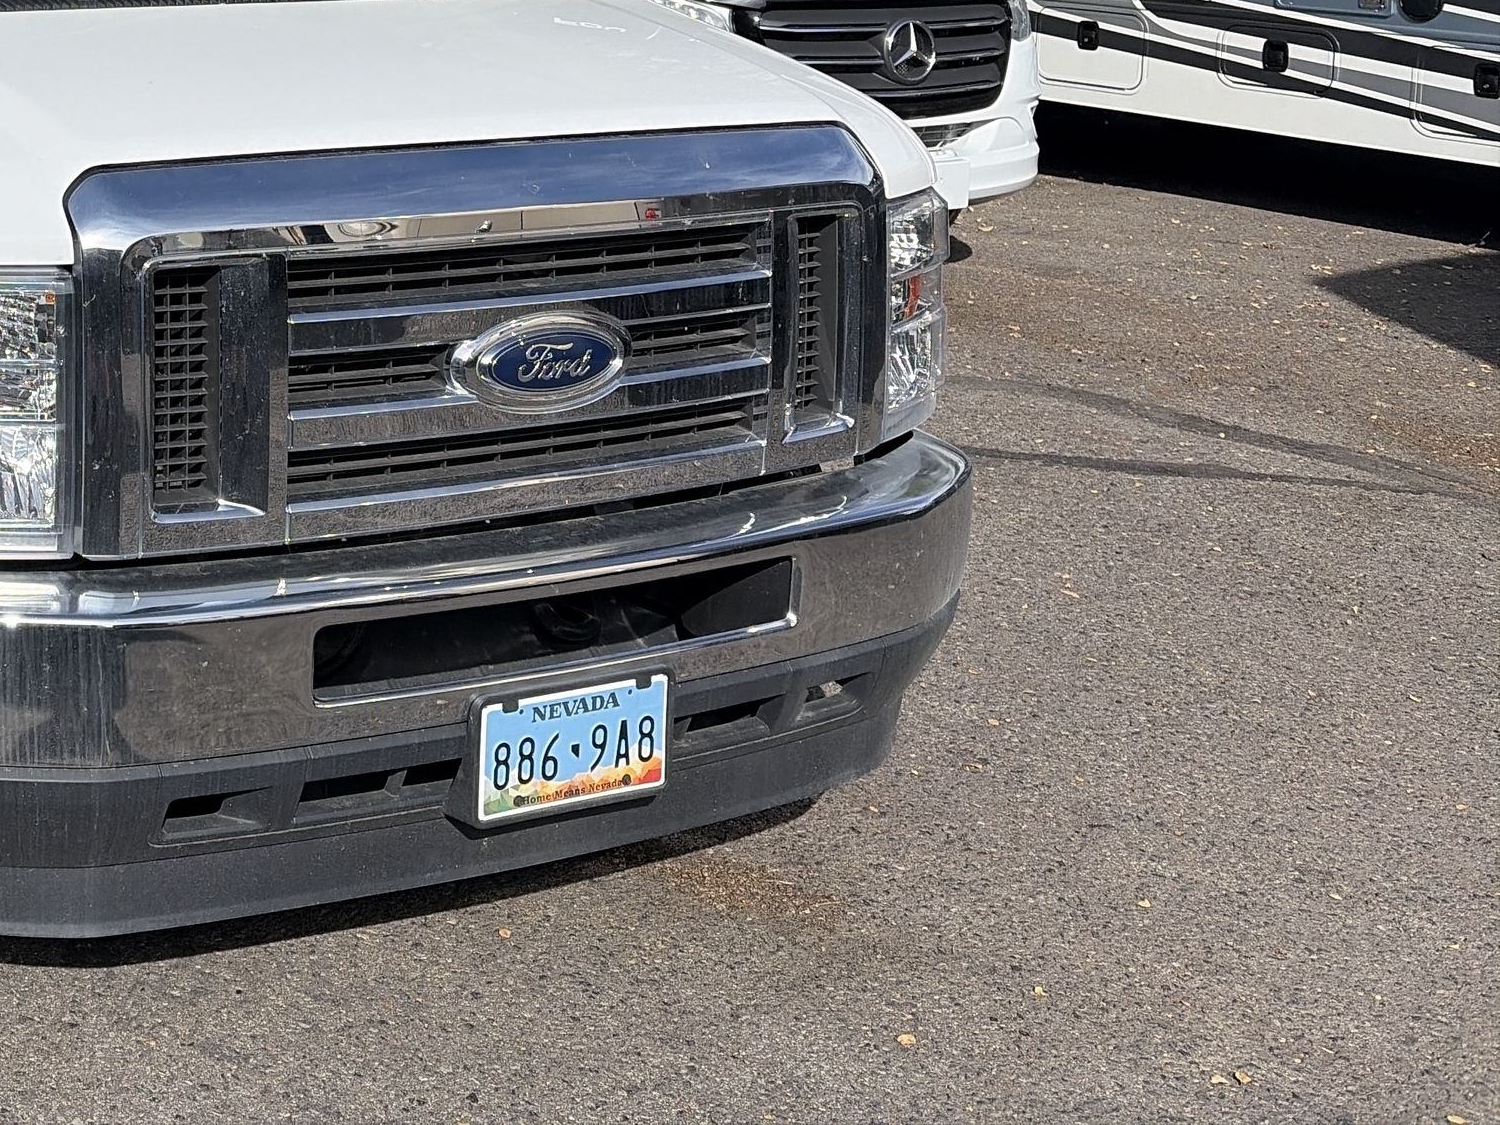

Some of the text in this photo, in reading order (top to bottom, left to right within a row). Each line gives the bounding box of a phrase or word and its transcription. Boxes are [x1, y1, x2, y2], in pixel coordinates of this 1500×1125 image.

[517, 342, 593, 383] Ford
[531, 691, 620, 724] NEVADA
[522, 778, 623, 806] Home Means Nevada
